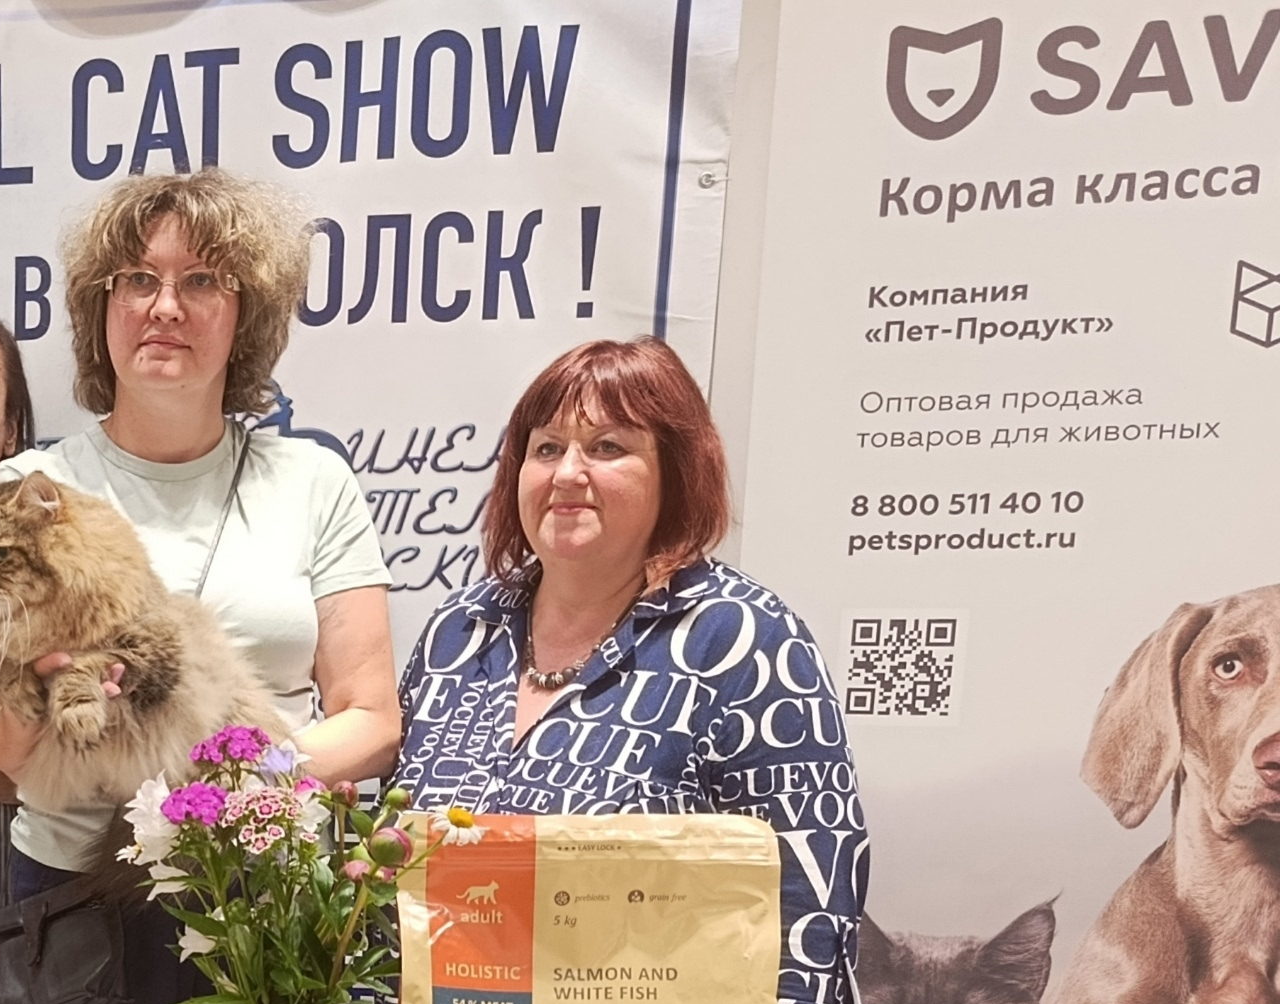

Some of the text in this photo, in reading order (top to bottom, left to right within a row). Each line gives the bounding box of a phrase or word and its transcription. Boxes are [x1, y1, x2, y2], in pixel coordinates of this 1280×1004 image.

[1030, 8, 1280, 116] SAV
[71, 48, 239, 180] CAT
[272, 24, 580, 169] SHOW
[879, 164, 1260, 223] Корма класса
[15, 256, 51, 341] В
[579, 206, 601, 318] !
[868, 281, 1029, 309] Компания
[865, 313, 1114, 345] «Пет-Продукт»
[860, 385, 1143, 414] Оптовая продажа
[857, 420, 1221, 453] товаров для животных
[850, 490, 1084, 517] 8 800 511 40 10
[848, 525, 1077, 556] petsproduct.ru
[574, 893, 610, 902] prebiotics
[671, 893, 687, 901] free
[461, 910, 503, 924] adult
[553, 915, 577, 927] 5 kg
[446, 963, 521, 980] HOLISTIC
[553, 967, 679, 981] SALMON AND
[554, 987, 658, 1000] WHITE FISH
